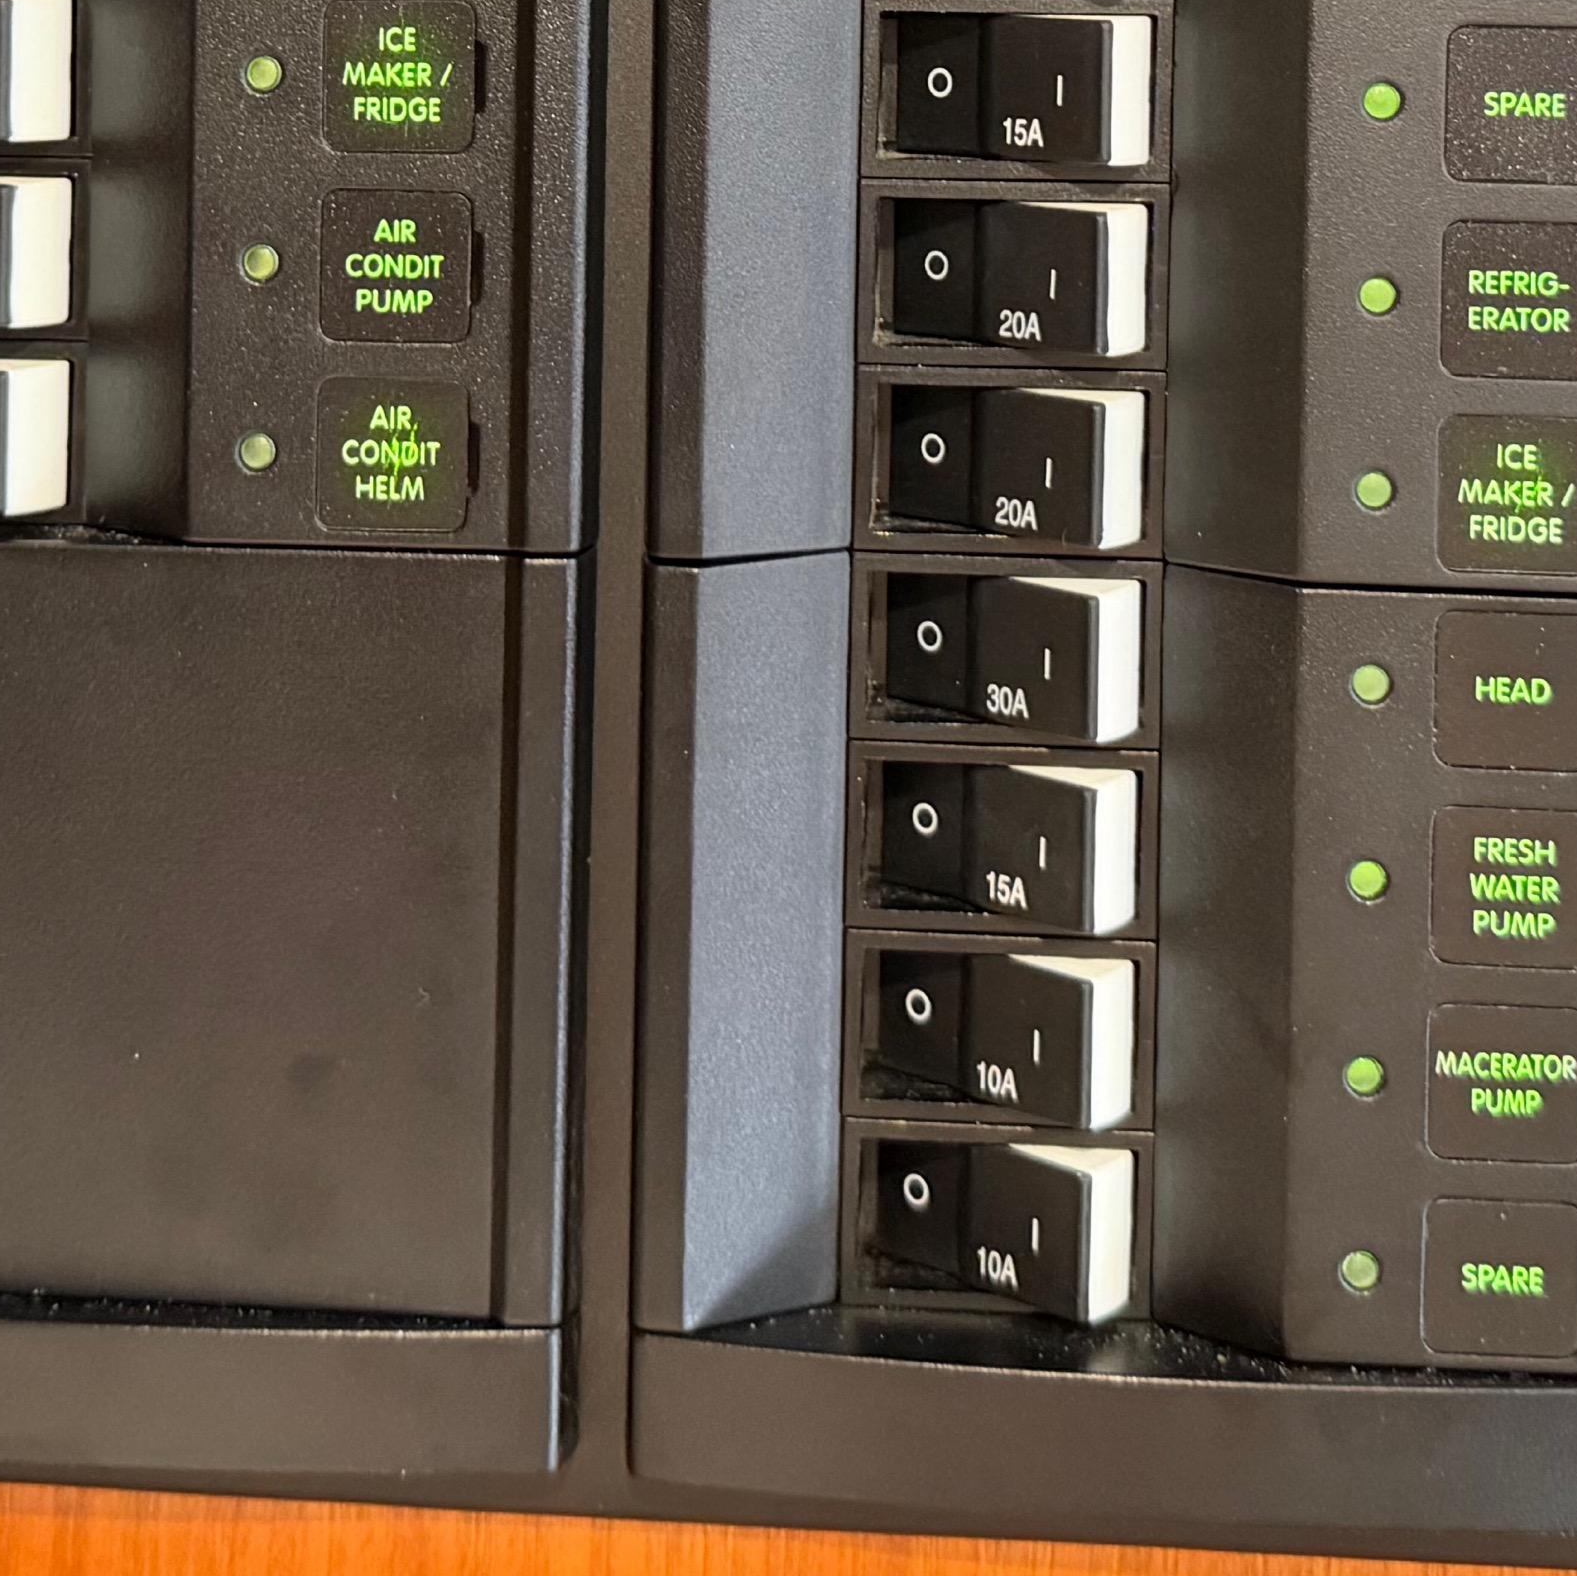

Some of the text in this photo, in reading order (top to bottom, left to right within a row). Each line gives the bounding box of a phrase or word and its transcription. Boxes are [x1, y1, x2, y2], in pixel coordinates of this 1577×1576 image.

[379, 27, 416, 53] ICE
[343, 62, 431, 88] MAKER
[354, 97, 440, 123] FRIDGE
[1484, 92, 1566, 117] SPARE
[1003, 118, 1043, 147] 15A
[374, 219, 416, 243] AIR
[346, 254, 444, 279] CONDIT
[1469, 270, 1570, 296] REFRIG-
[356, 289, 433, 313] PUMP
[999, 310, 1041, 341] 20A
[1469, 307, 1570, 332] ERATOR
[370, 405, 411, 432] AIR
[342, 440, 440, 465] CONDIT
[1497, 444, 1539, 472] ICE
[356, 475, 424, 500] HELM
[1458, 476, 1553, 506] MAKER
[995, 497, 1037, 530] 20A
[1470, 515, 1562, 543] FRIDGE
[987, 684, 1028, 718] 30A
[1476, 676, 1552, 704] HEAD
[1474, 837, 1555, 865] FRESH
[987, 871, 1026, 908] 15A
[1470, 873, 1560, 903] WATER
[1473, 910, 1555, 938] PUMP
[1436, 1051, 1577, 1081] MACERATOR
[977, 1061, 1017, 1100] 10A
[1472, 1088, 1542, 1116] PUMP
[978, 1247, 1017, 1286] 10A
[1462, 1263, 1543, 1295] SPARE
